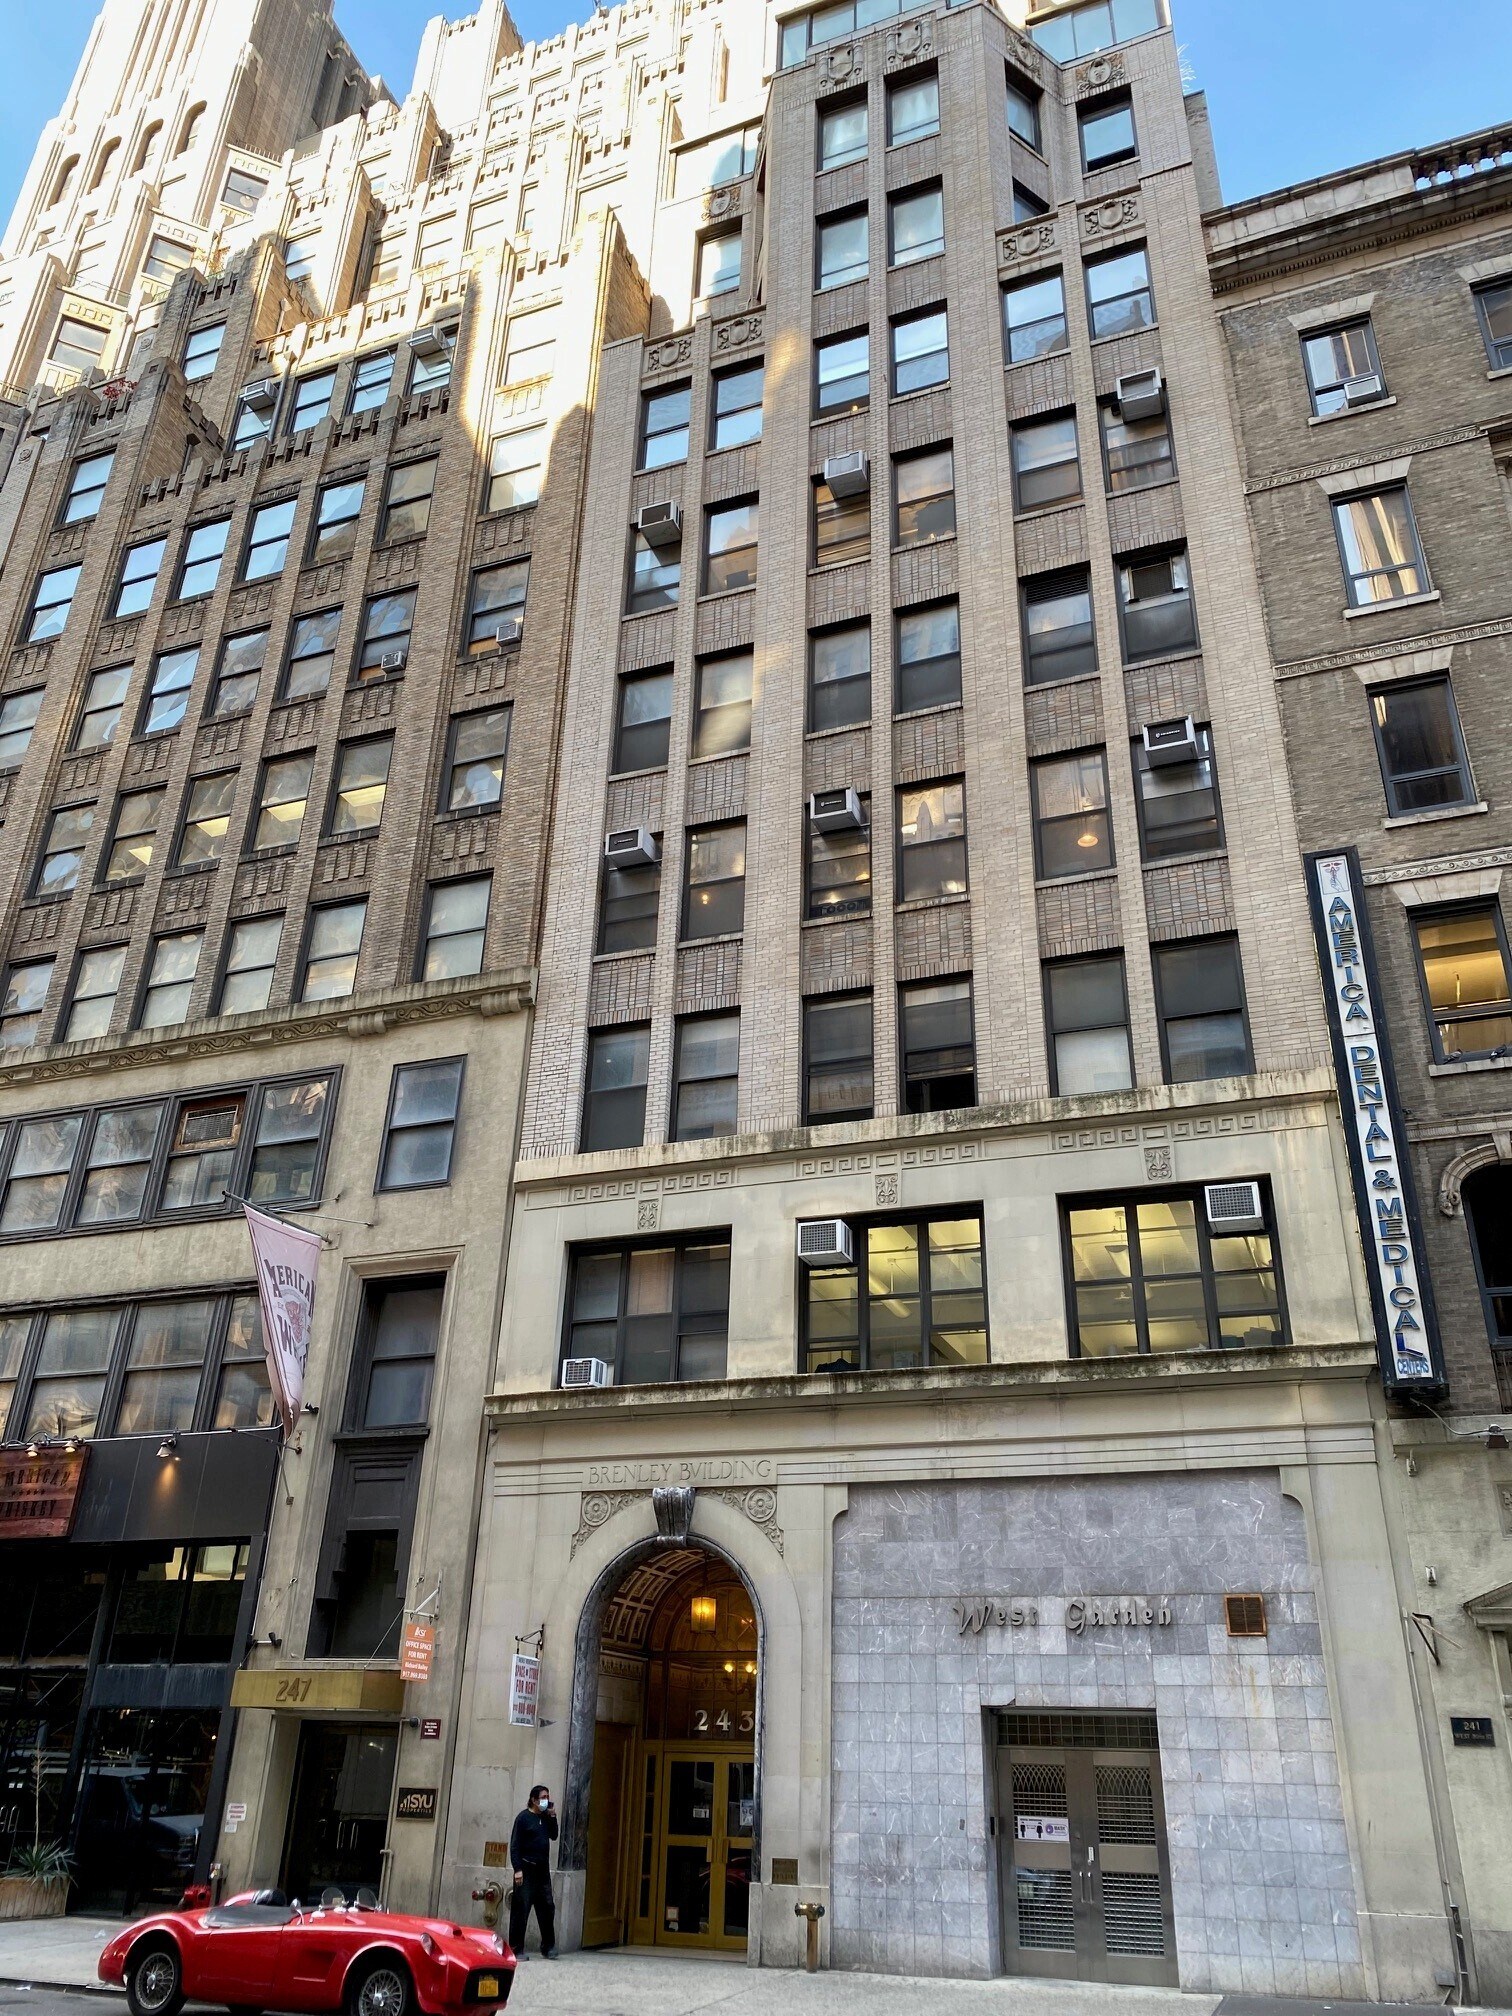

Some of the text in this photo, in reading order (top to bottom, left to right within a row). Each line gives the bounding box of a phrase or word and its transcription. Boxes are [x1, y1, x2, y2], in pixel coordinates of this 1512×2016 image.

[1350, 1046, 1391, 1162] DENTAL
[1372, 1169, 1397, 1190] &
[1375, 1197, 1424, 1358] MEDICAL
[1397, 1358, 1429, 1374] CENTERS
[588, 1464, 673, 1485] BRENLEY
[953, 1597, 1172, 1635] West Garden
[405, 1640, 432, 1651] OFFICE SPACE
[276, 1677, 312, 1702] 247
[516, 1679, 536, 1695] FOR RENT
[693, 1708, 754, 1732] 243
[1464, 1721, 1480, 1730] 241
